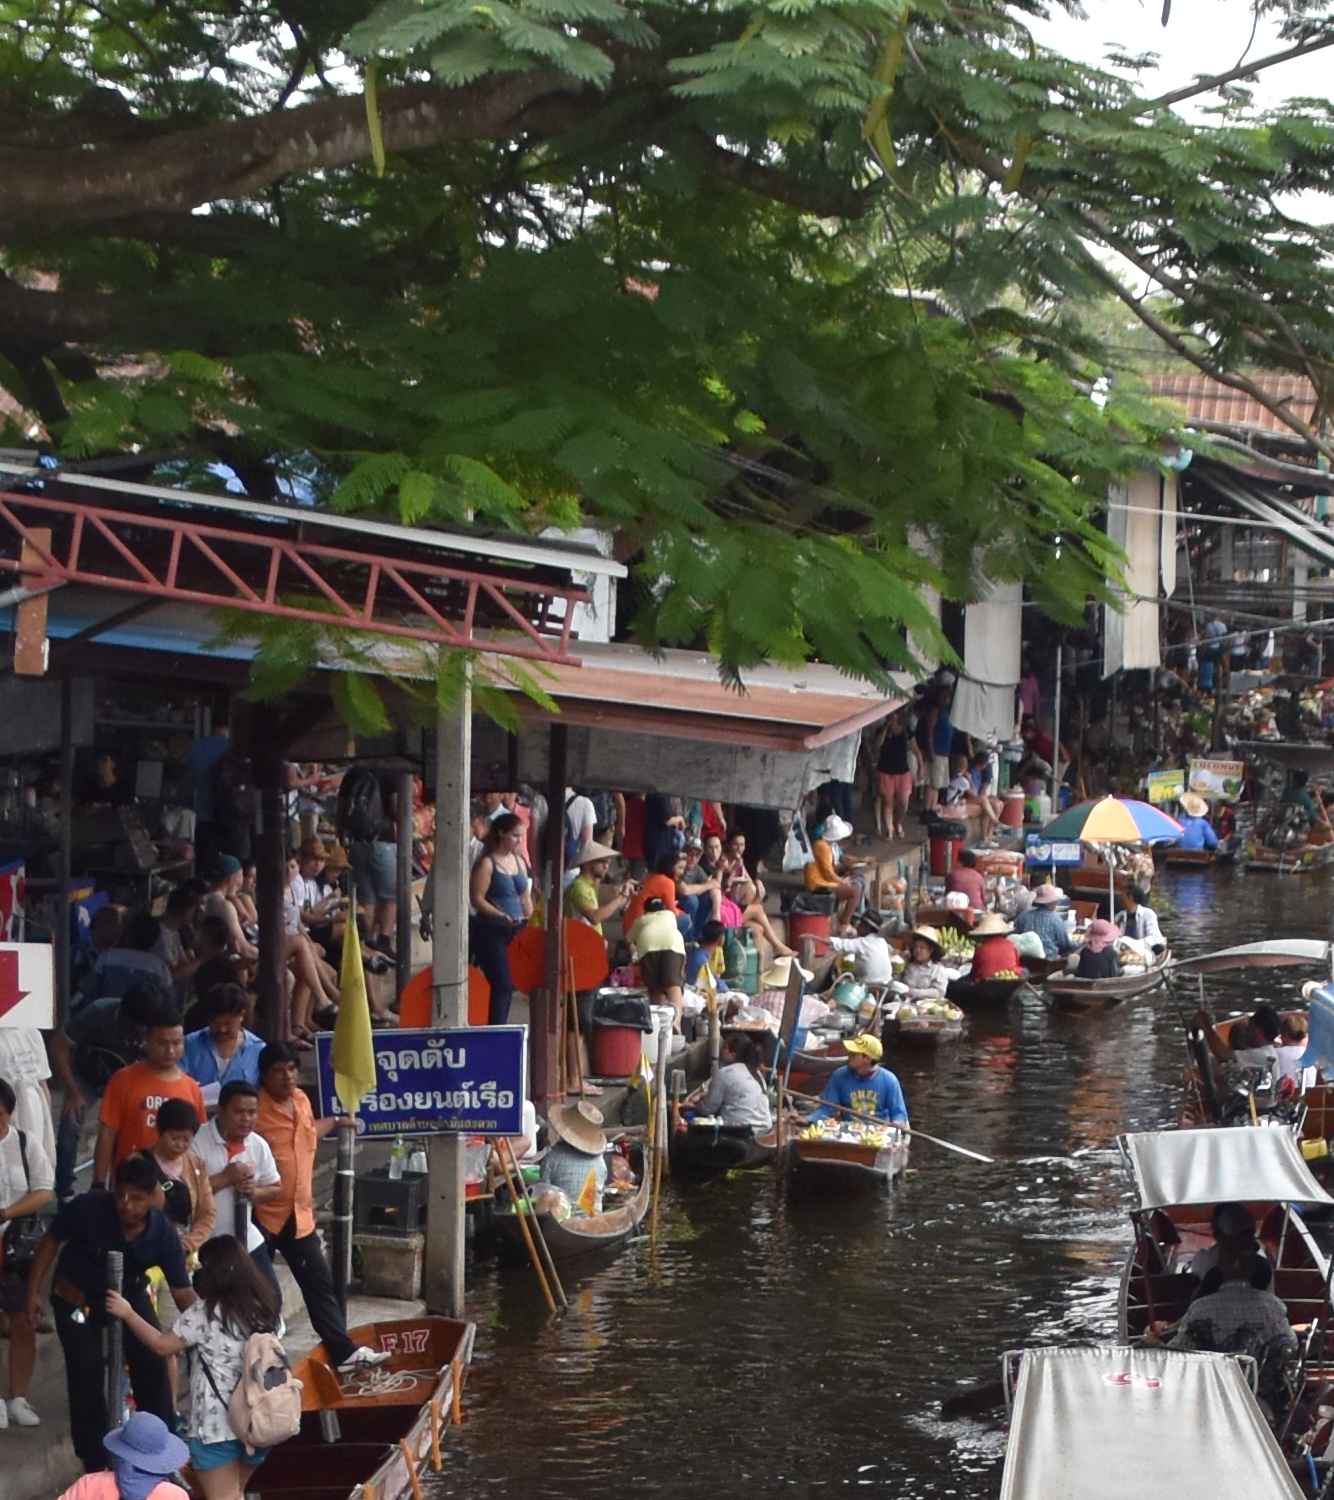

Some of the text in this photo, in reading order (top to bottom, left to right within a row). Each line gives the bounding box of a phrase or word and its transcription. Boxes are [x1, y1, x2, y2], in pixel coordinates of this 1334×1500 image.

[376, 1038, 466, 1083] จุดดับ
[380, 1329, 430, 1355] F.17
